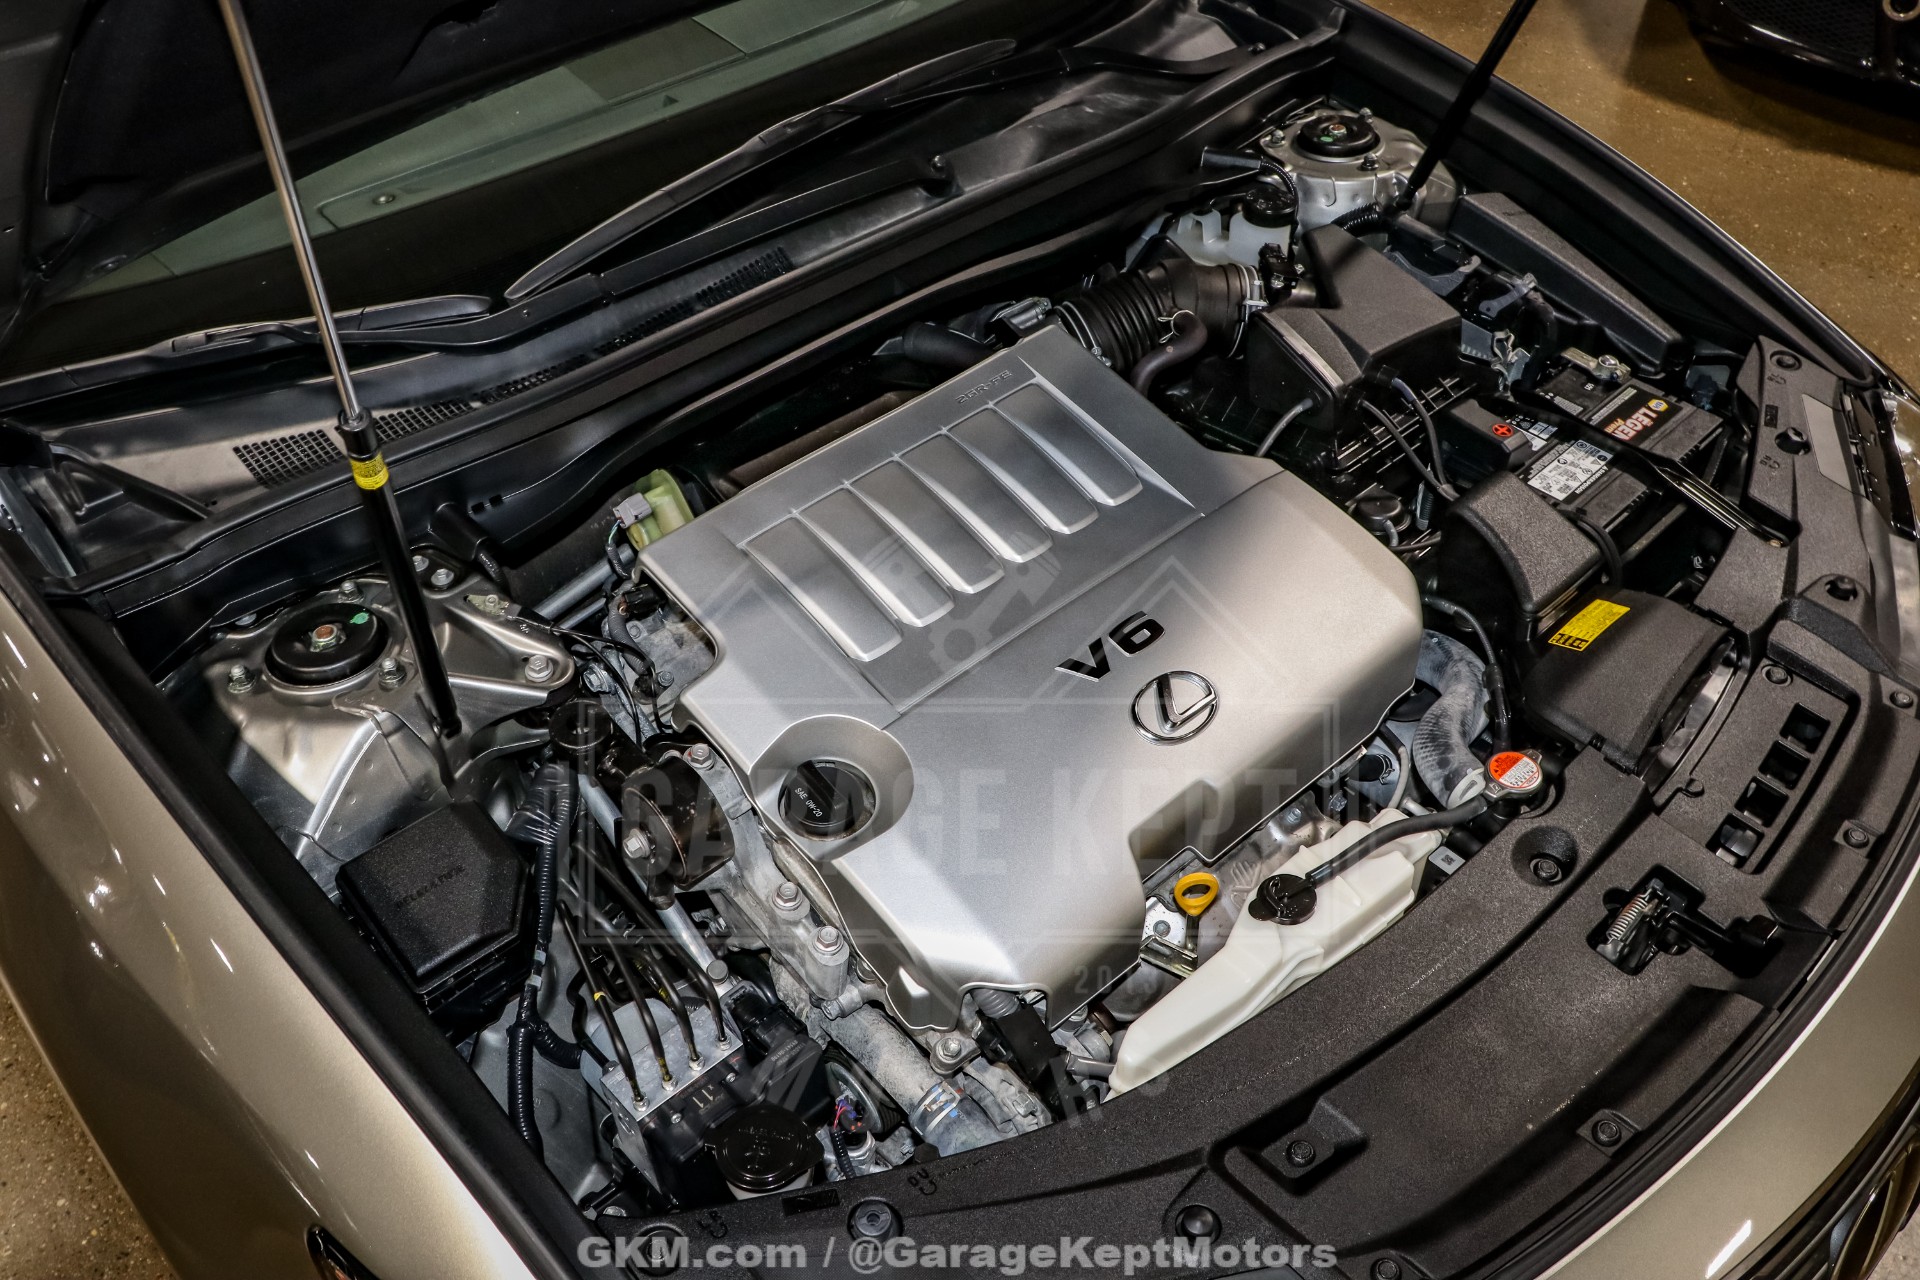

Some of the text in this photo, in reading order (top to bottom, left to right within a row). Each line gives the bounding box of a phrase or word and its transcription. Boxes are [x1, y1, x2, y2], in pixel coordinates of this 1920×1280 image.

[1054, 610, 1166, 682] V6
[795, 787, 822, 817] SAE 0W-20
